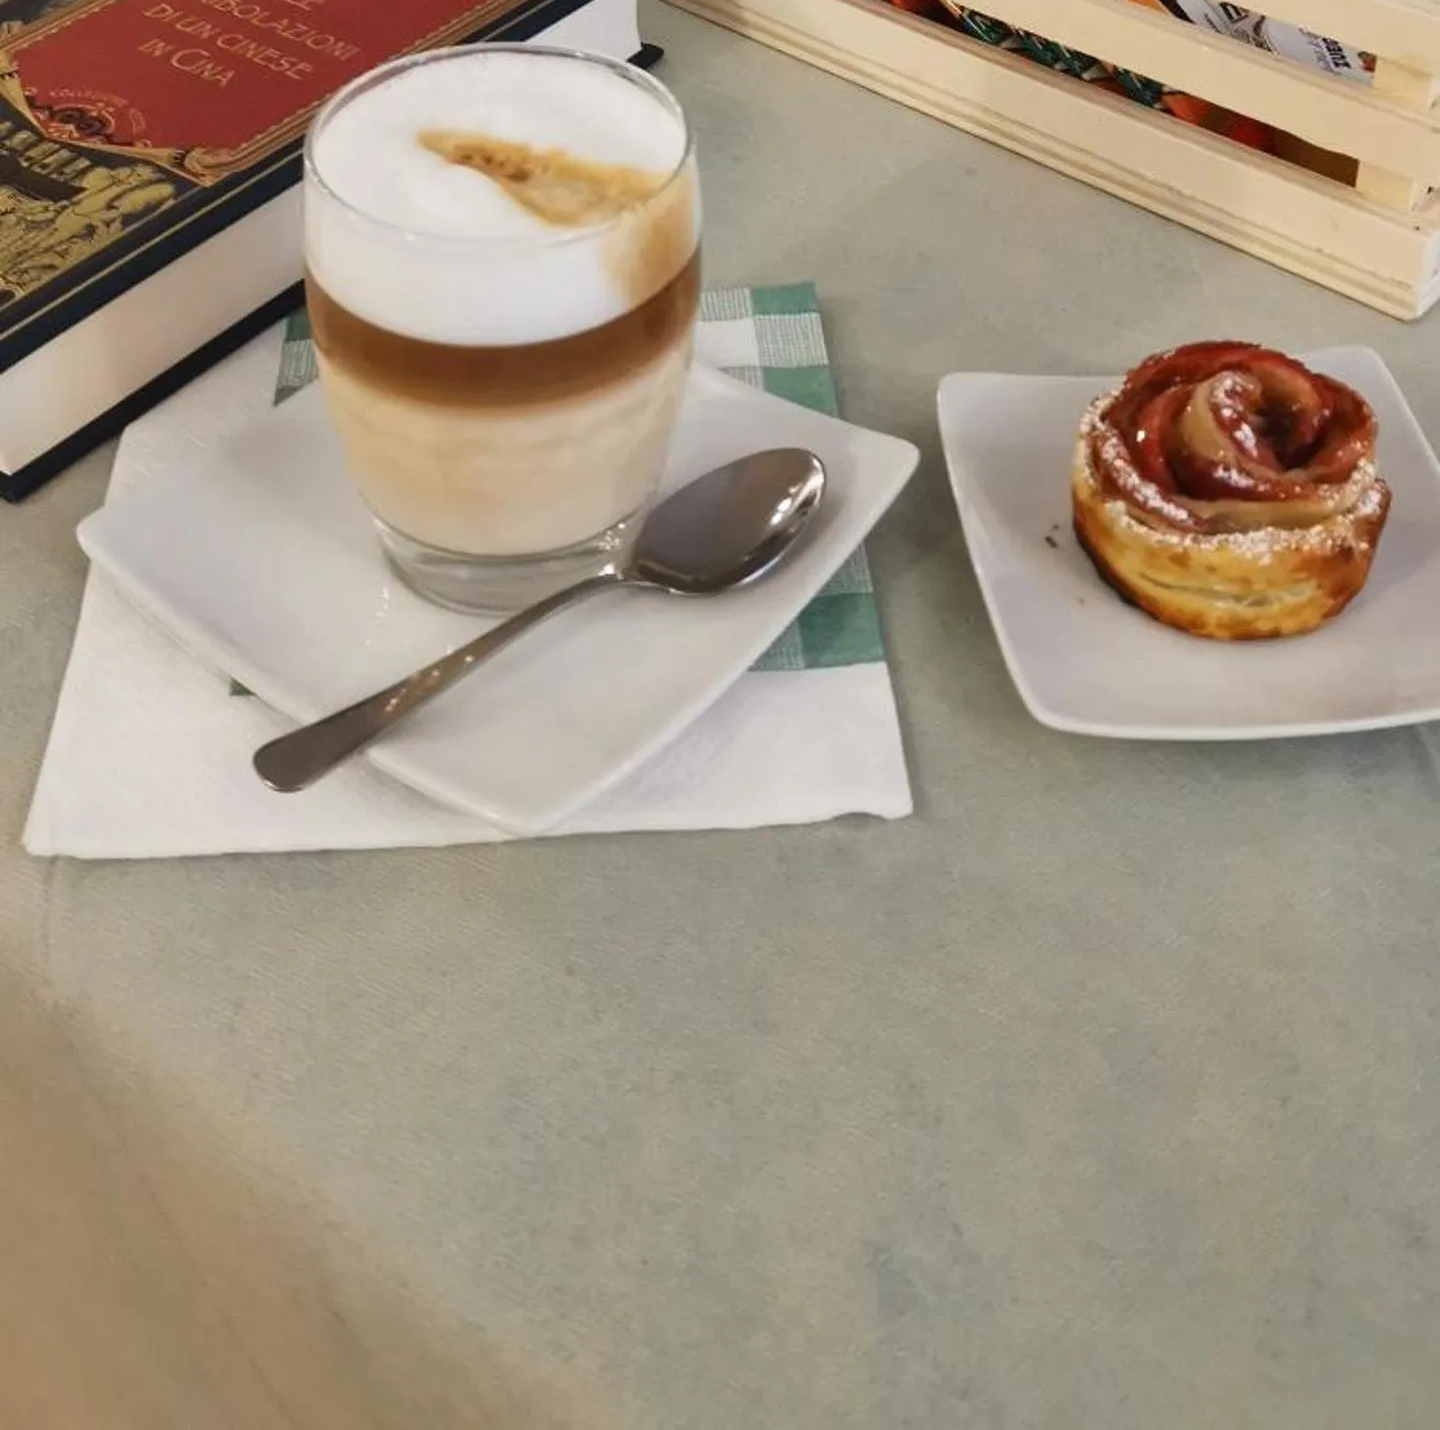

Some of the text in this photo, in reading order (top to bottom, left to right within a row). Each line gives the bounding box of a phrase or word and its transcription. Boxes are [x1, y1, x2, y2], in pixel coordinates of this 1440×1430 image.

[141, 3, 313, 80] DI UN CINESE
